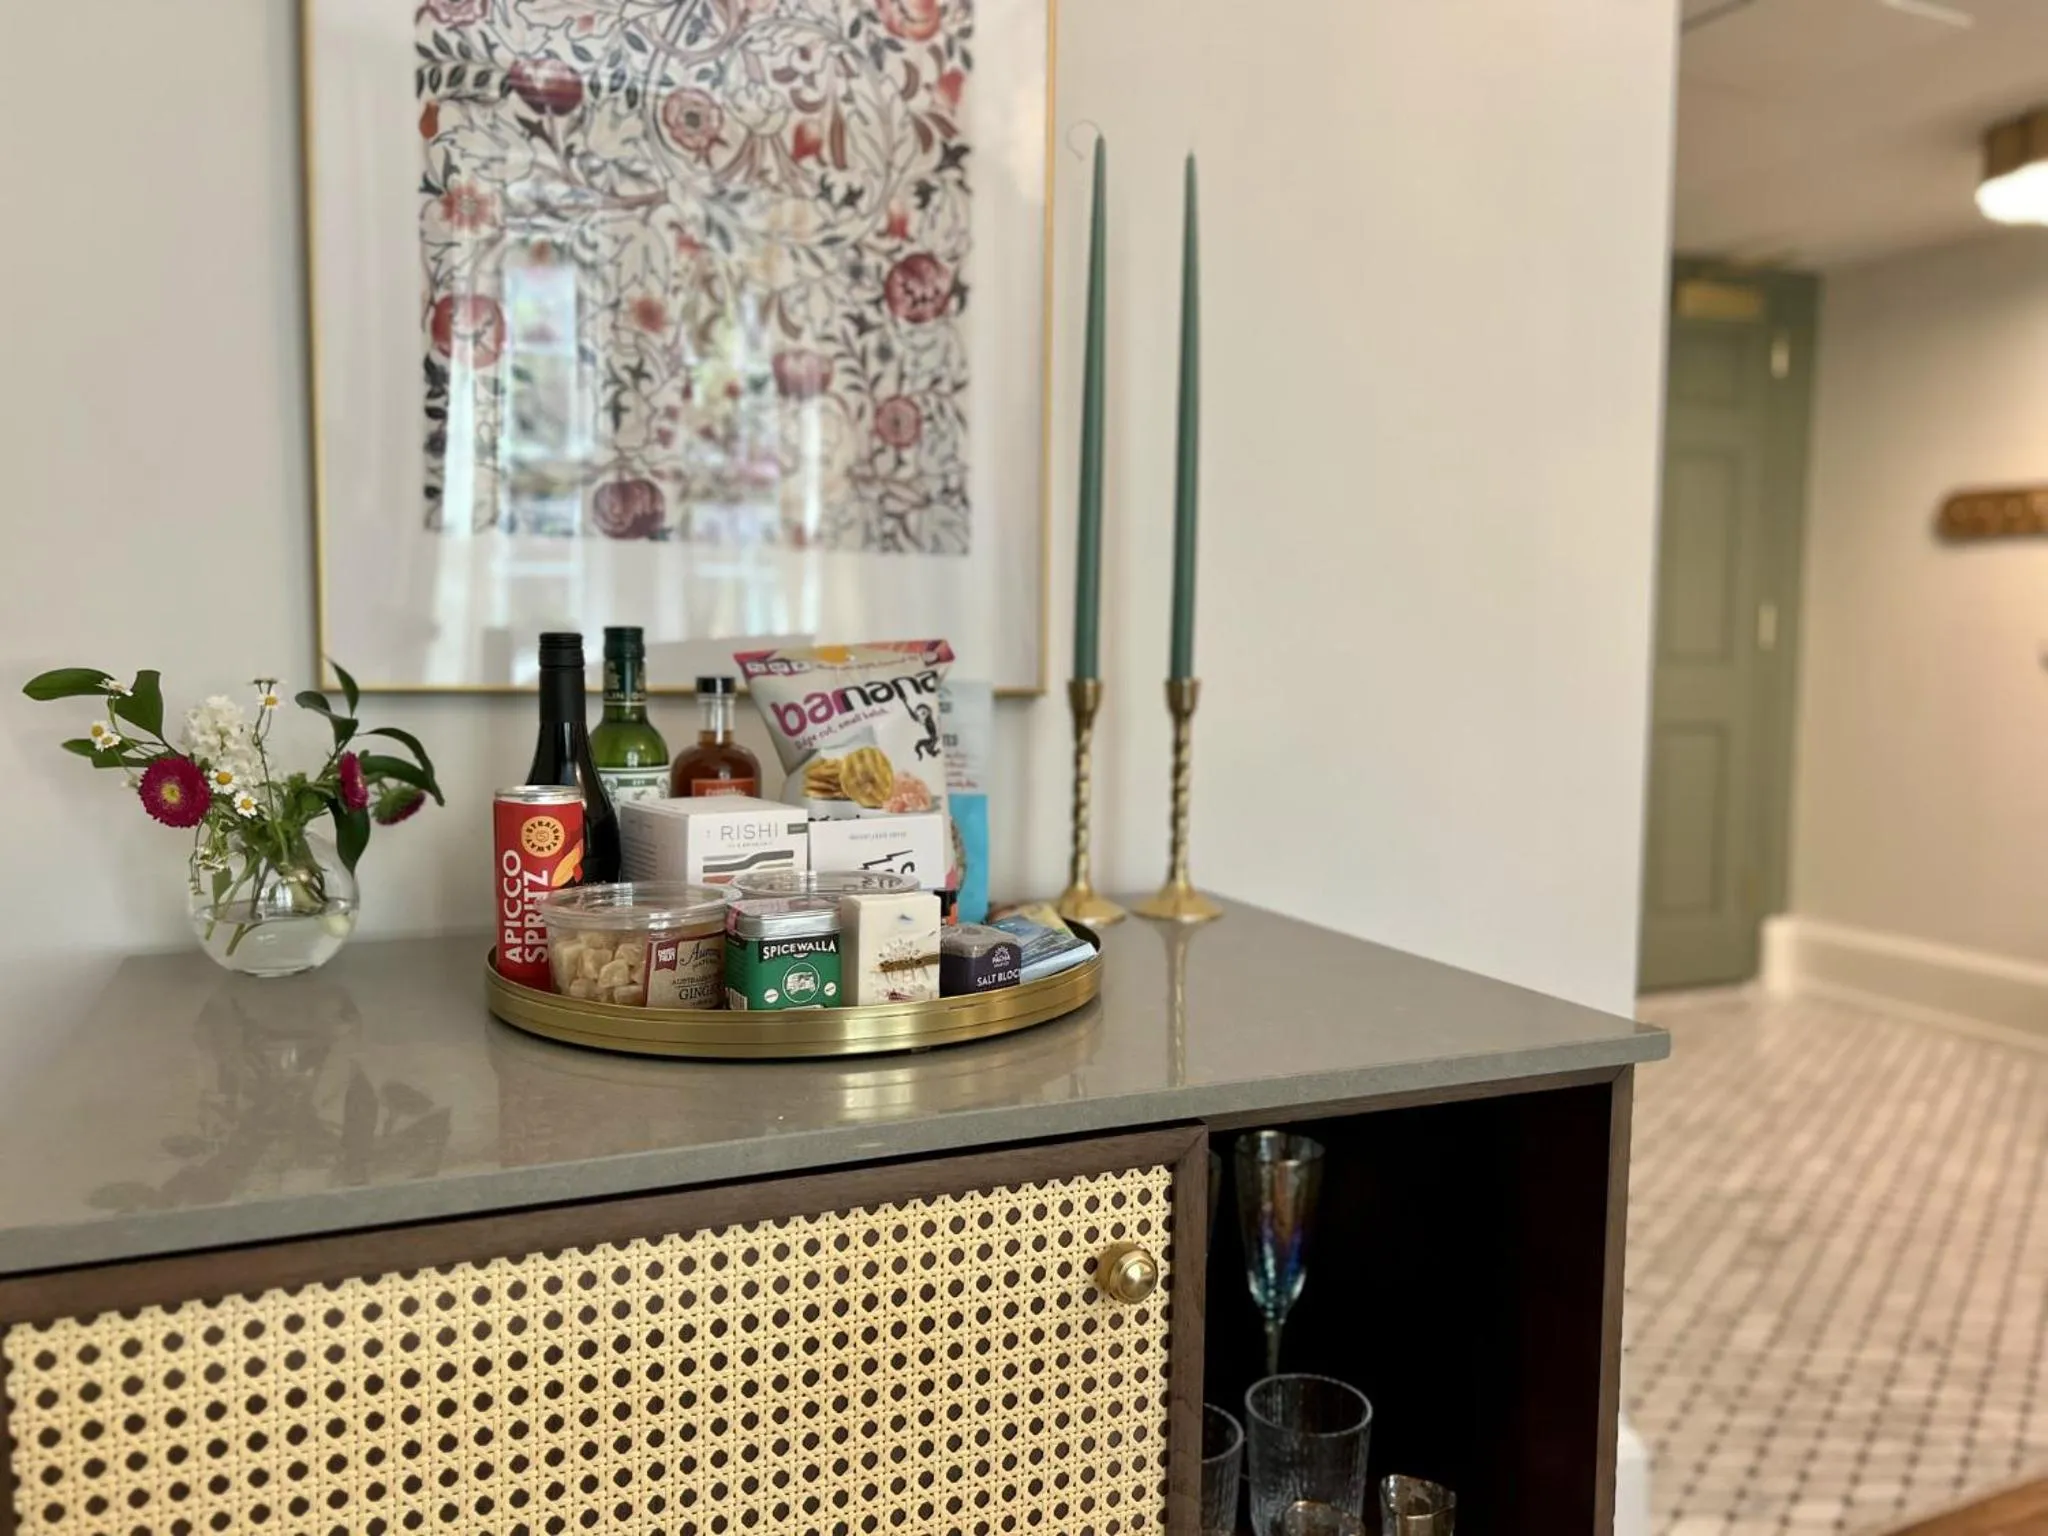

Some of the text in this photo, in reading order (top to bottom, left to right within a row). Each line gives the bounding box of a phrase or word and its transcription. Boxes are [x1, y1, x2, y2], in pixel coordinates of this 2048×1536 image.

[721, 822, 778, 841] RISHI
[503, 850, 523, 964] APICCO
[523, 870, 549, 964] SPRITZ
[762, 940, 836, 960] SPICEWALLA
[976, 973, 997, 987] SALT
